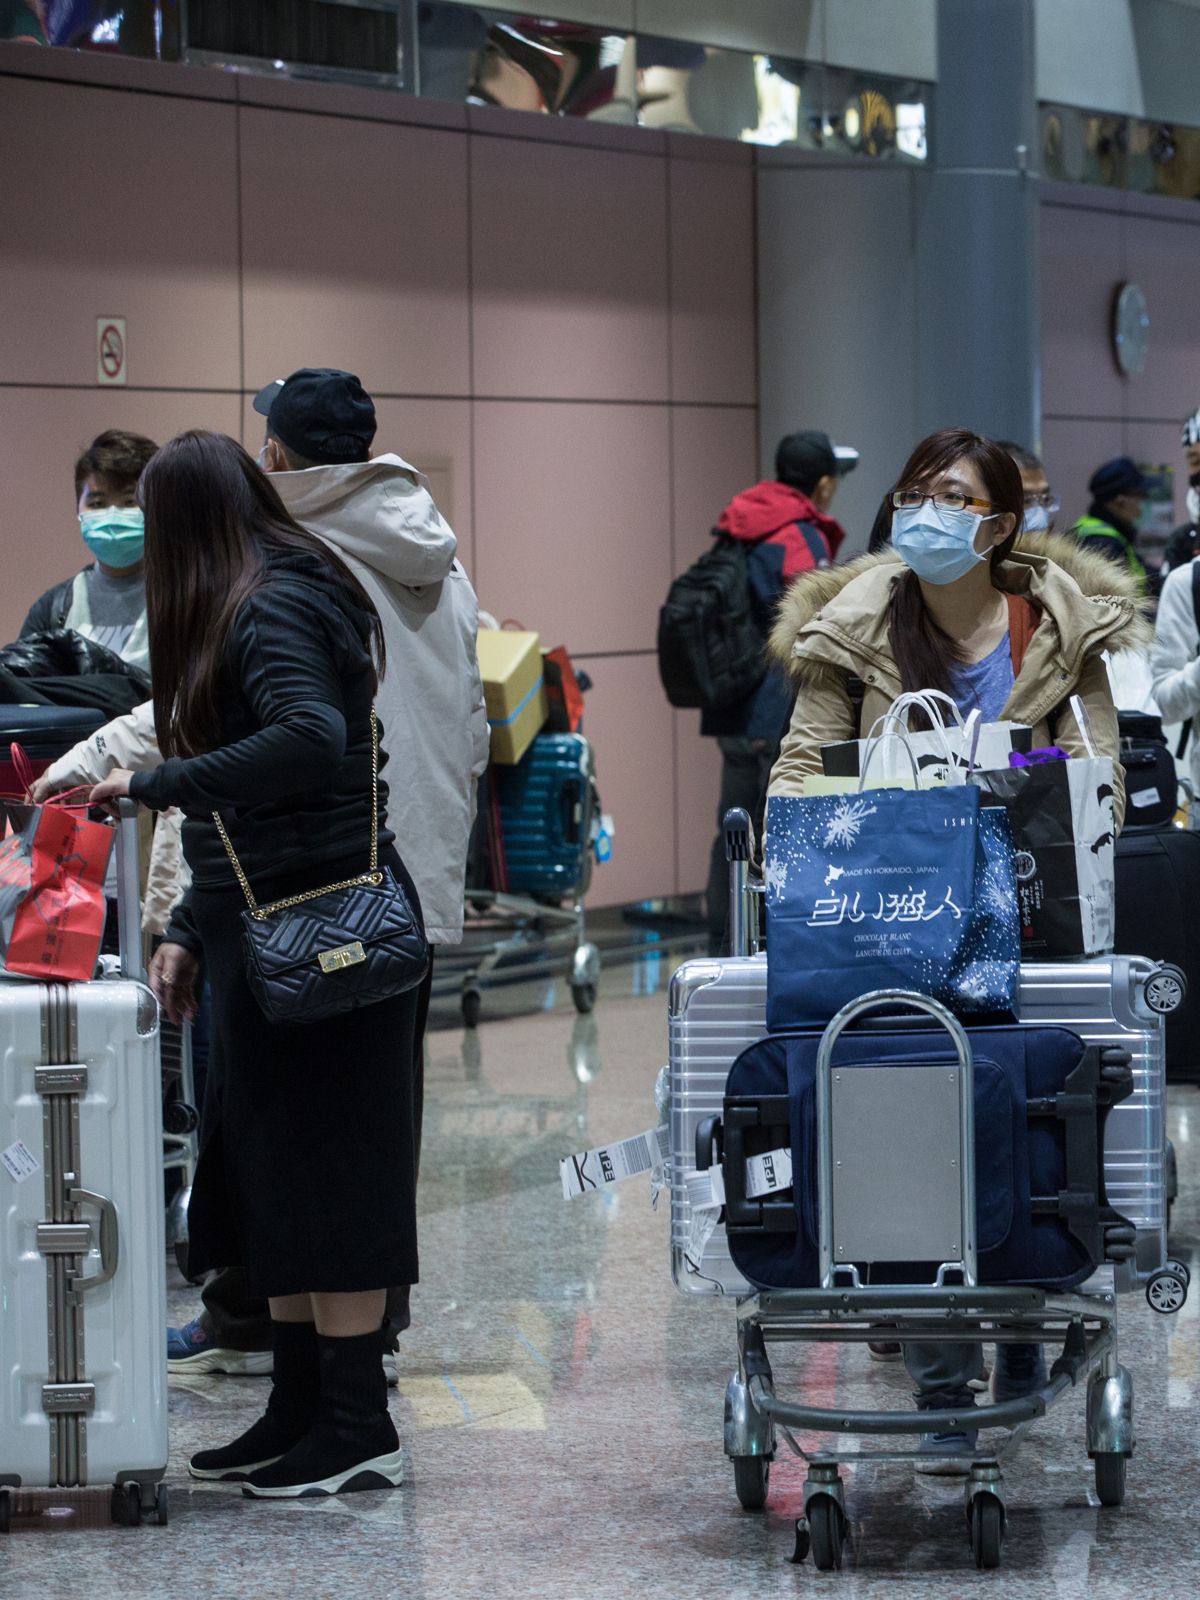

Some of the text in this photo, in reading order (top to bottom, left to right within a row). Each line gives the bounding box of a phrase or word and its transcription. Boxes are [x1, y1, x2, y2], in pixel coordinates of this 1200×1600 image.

[944, 816, 979, 827] ISHI
[843, 868, 862, 877] MADE
[873, 866, 913, 875] HOKKAIDO,
[916, 866, 939, 874] JAPAN
[853, 932, 912, 943] CHOCOLAT BLANC
